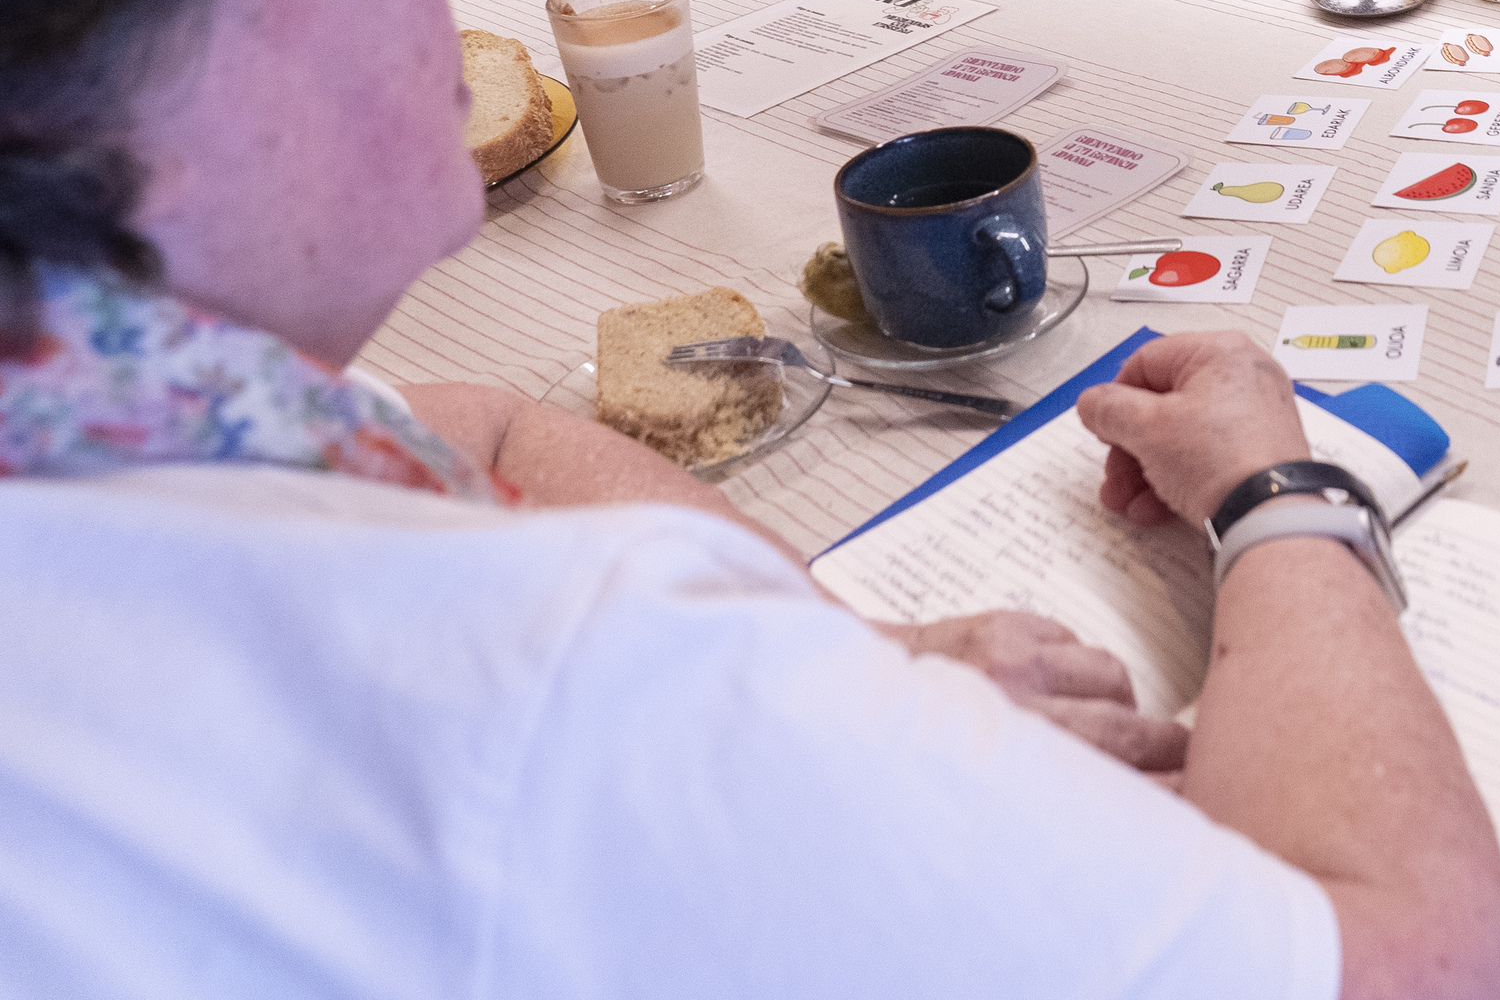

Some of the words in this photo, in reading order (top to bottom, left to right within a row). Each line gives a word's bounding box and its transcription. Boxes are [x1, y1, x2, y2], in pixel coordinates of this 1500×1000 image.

[961, 56, 1025, 74] BIENVENIDO
[1379, 46, 1420, 85] ALBONDIGAK
[1321, 108, 1352, 139] EDARIAK
[1074, 134, 1144, 161] BIENVENIDO
[1088, 151, 1139, 170] BRUNCH
[1285, 178, 1315, 211] UDAREA
[1222, 247, 1252, 292] SAGARRA
[1445, 239, 1473, 272] LIMOIA
